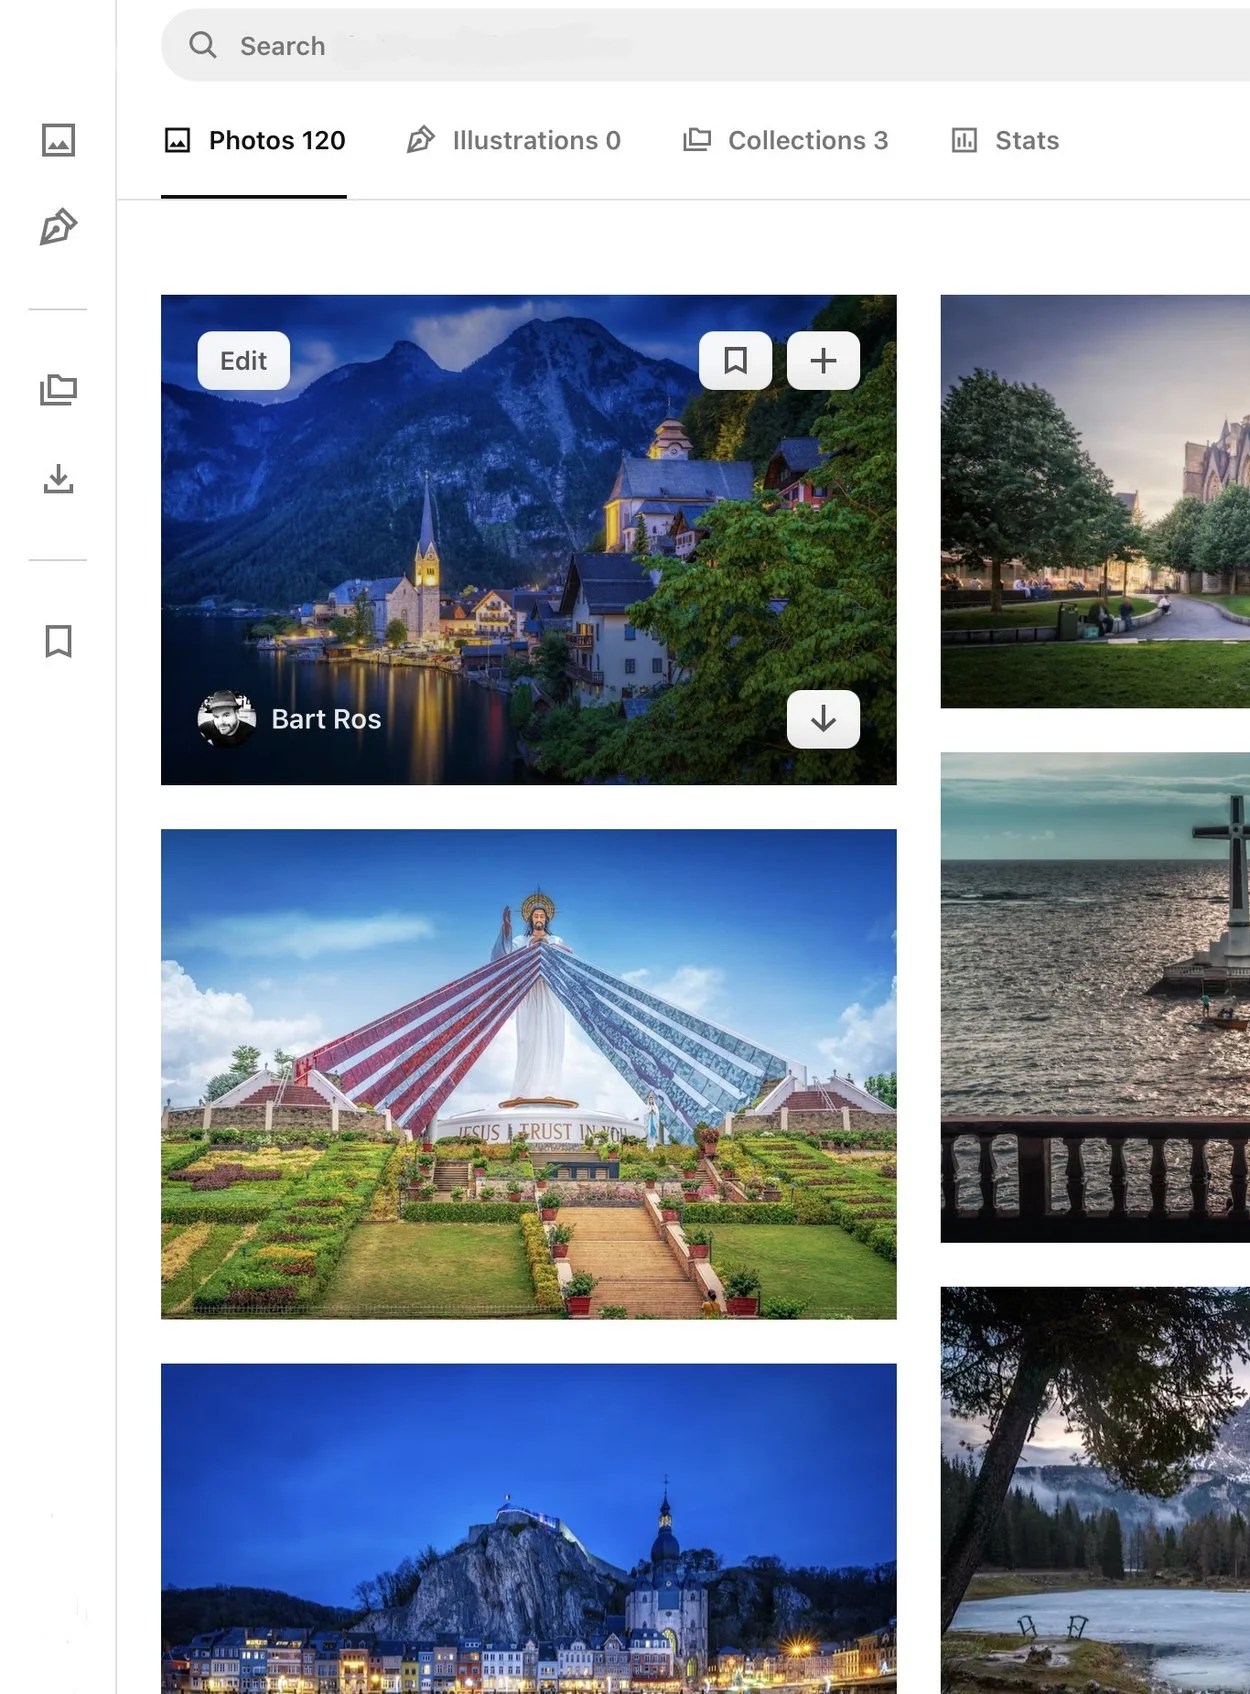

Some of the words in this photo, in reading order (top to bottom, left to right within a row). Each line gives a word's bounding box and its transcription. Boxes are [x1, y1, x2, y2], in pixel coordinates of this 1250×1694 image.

[240, 35, 325, 56] Search
[209, 129, 295, 151] Photos
[302, 130, 346, 151] 120
[453, 129, 599, 150] Illustrations
[606, 130, 621, 151] 0
[728, 129, 866, 151] Collections
[874, 130, 889, 150] 3
[996, 130, 1060, 151] Stats
[220, 349, 268, 371] Edit
[272, 708, 326, 730] Bart
[334, 708, 382, 730] Ros
[459, 1124, 500, 1141] JESUS
[519, 1123, 573, 1140] TRUST
[579, 1124, 596, 1140] IN
